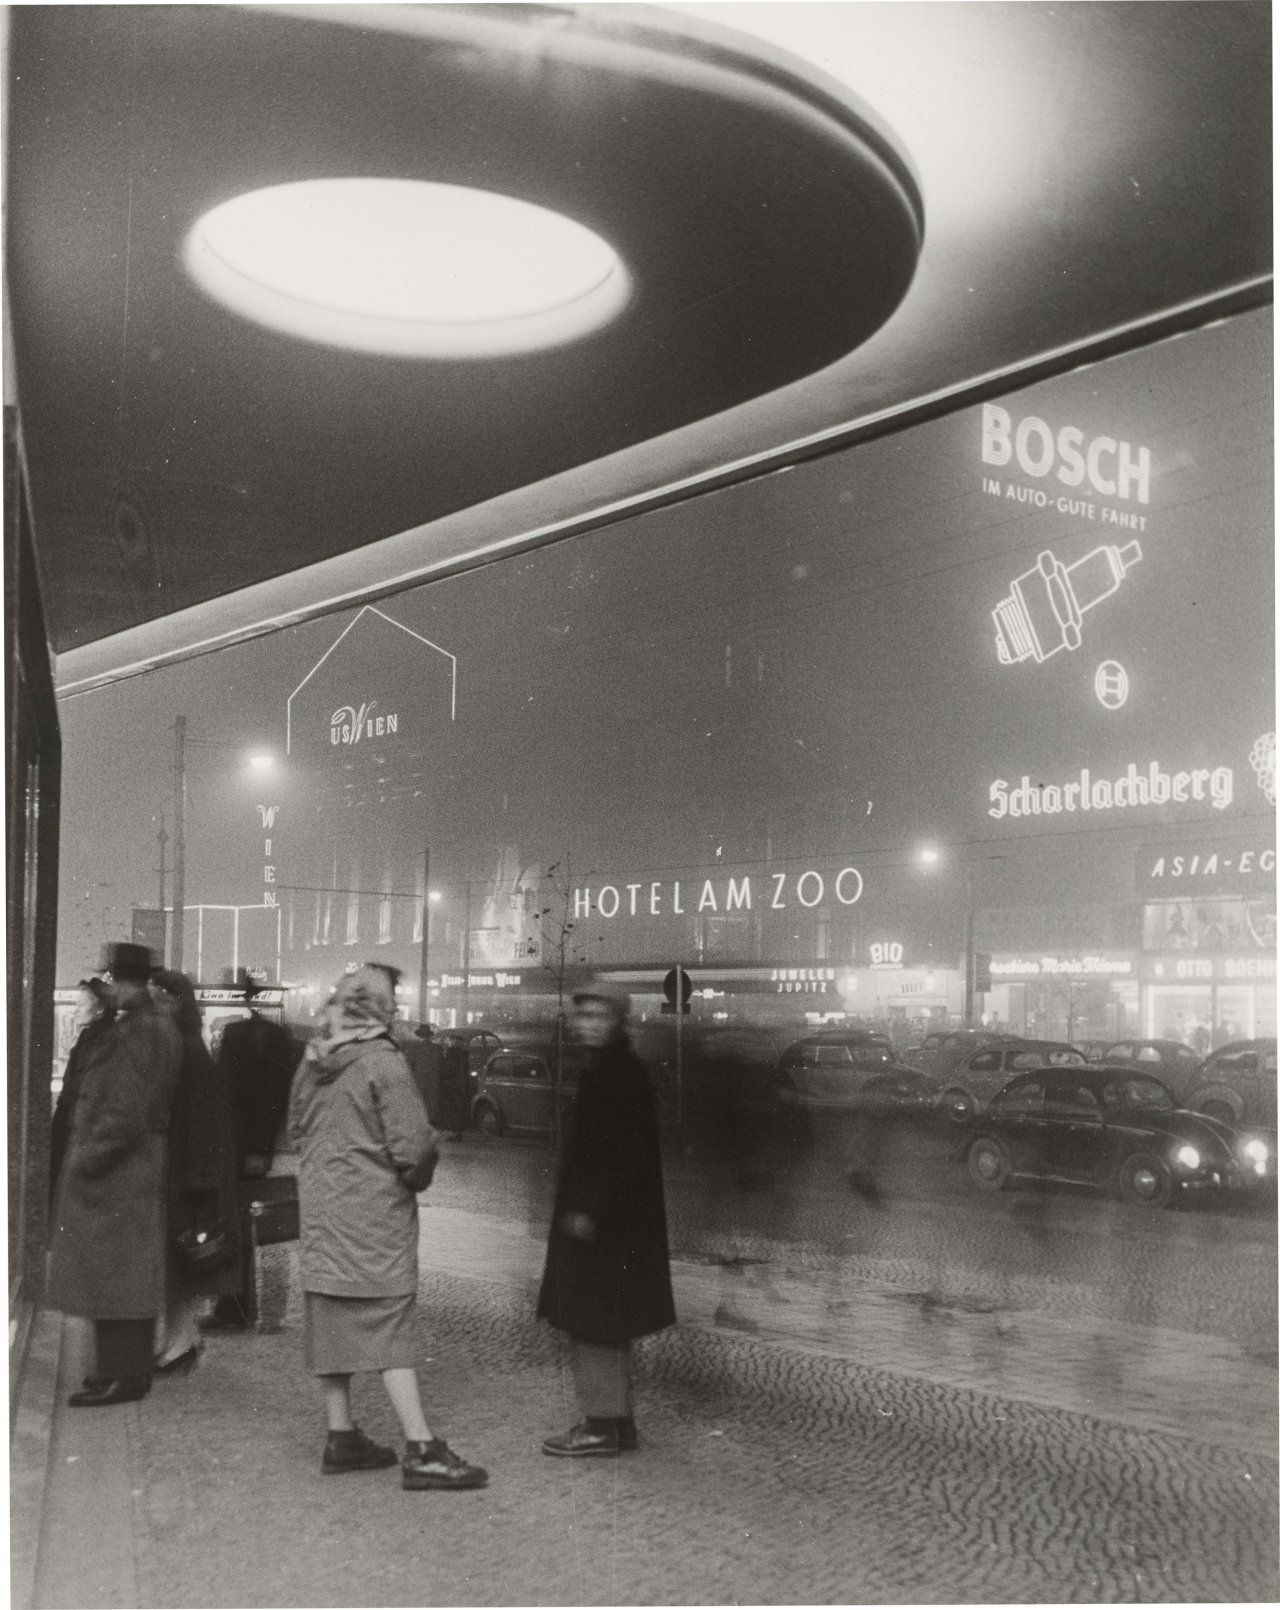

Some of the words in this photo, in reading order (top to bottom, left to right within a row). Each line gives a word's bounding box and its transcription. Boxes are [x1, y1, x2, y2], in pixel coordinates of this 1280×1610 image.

[982, 403, 1151, 504] BOSCH
[982, 478, 1001, 497] IM
[1102, 507, 1147, 531] FAHRT
[988, 761, 1233, 819] Scharlachberg
[574, 881, 685, 919] HOTEL
[698, 876, 752, 912] AM
[771, 867, 863, 909] ZOO
[1176, 959, 1213, 978] OTTO
